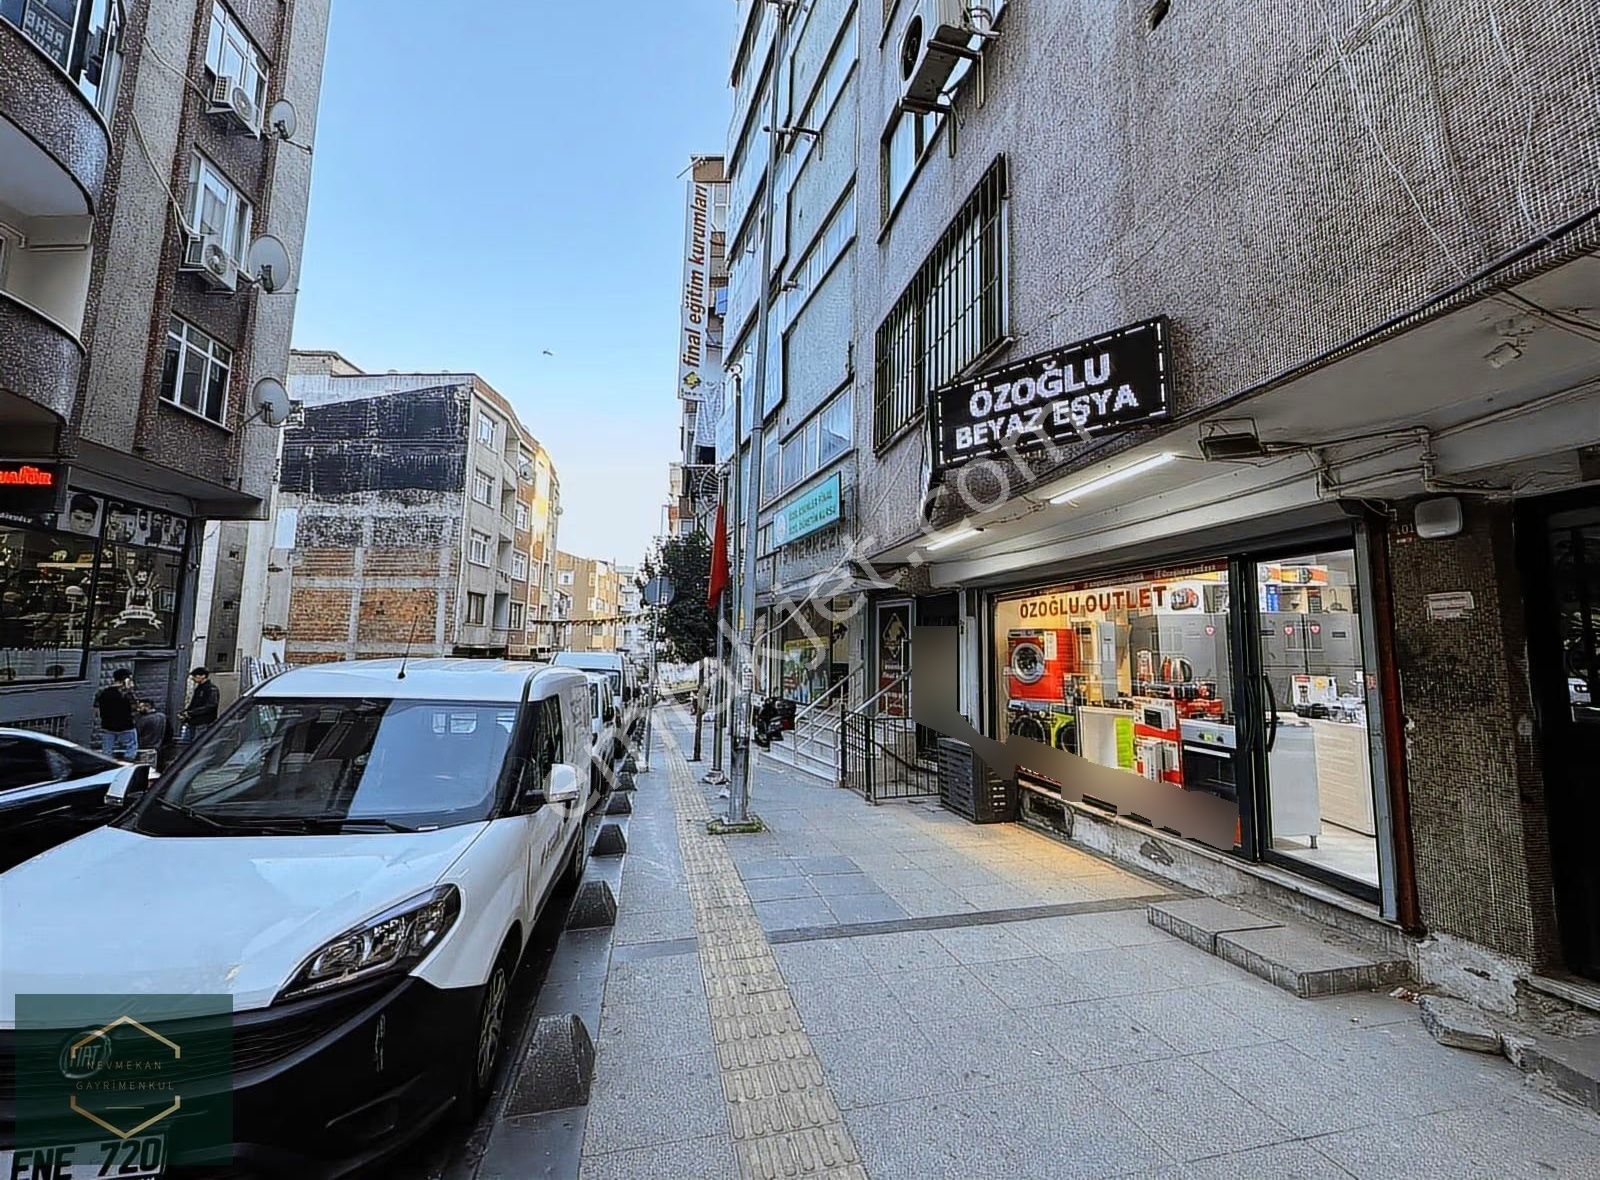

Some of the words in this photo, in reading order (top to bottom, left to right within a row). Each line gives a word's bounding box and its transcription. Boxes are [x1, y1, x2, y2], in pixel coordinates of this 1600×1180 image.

[689, 184, 708, 266] kurumları
[686, 269, 706, 324] eğitim
[683, 327, 701, 368] final
[969, 353, 1111, 418] ÖZOĞLU
[956, 407, 1043, 450] BEYAZ
[1053, 384, 1139, 426] EŞYA
[1020, 595, 1079, 619] ÖZOĞLU
[1085, 586, 1168, 613] OUTLET
[98, 1138, 162, 1177] 720
